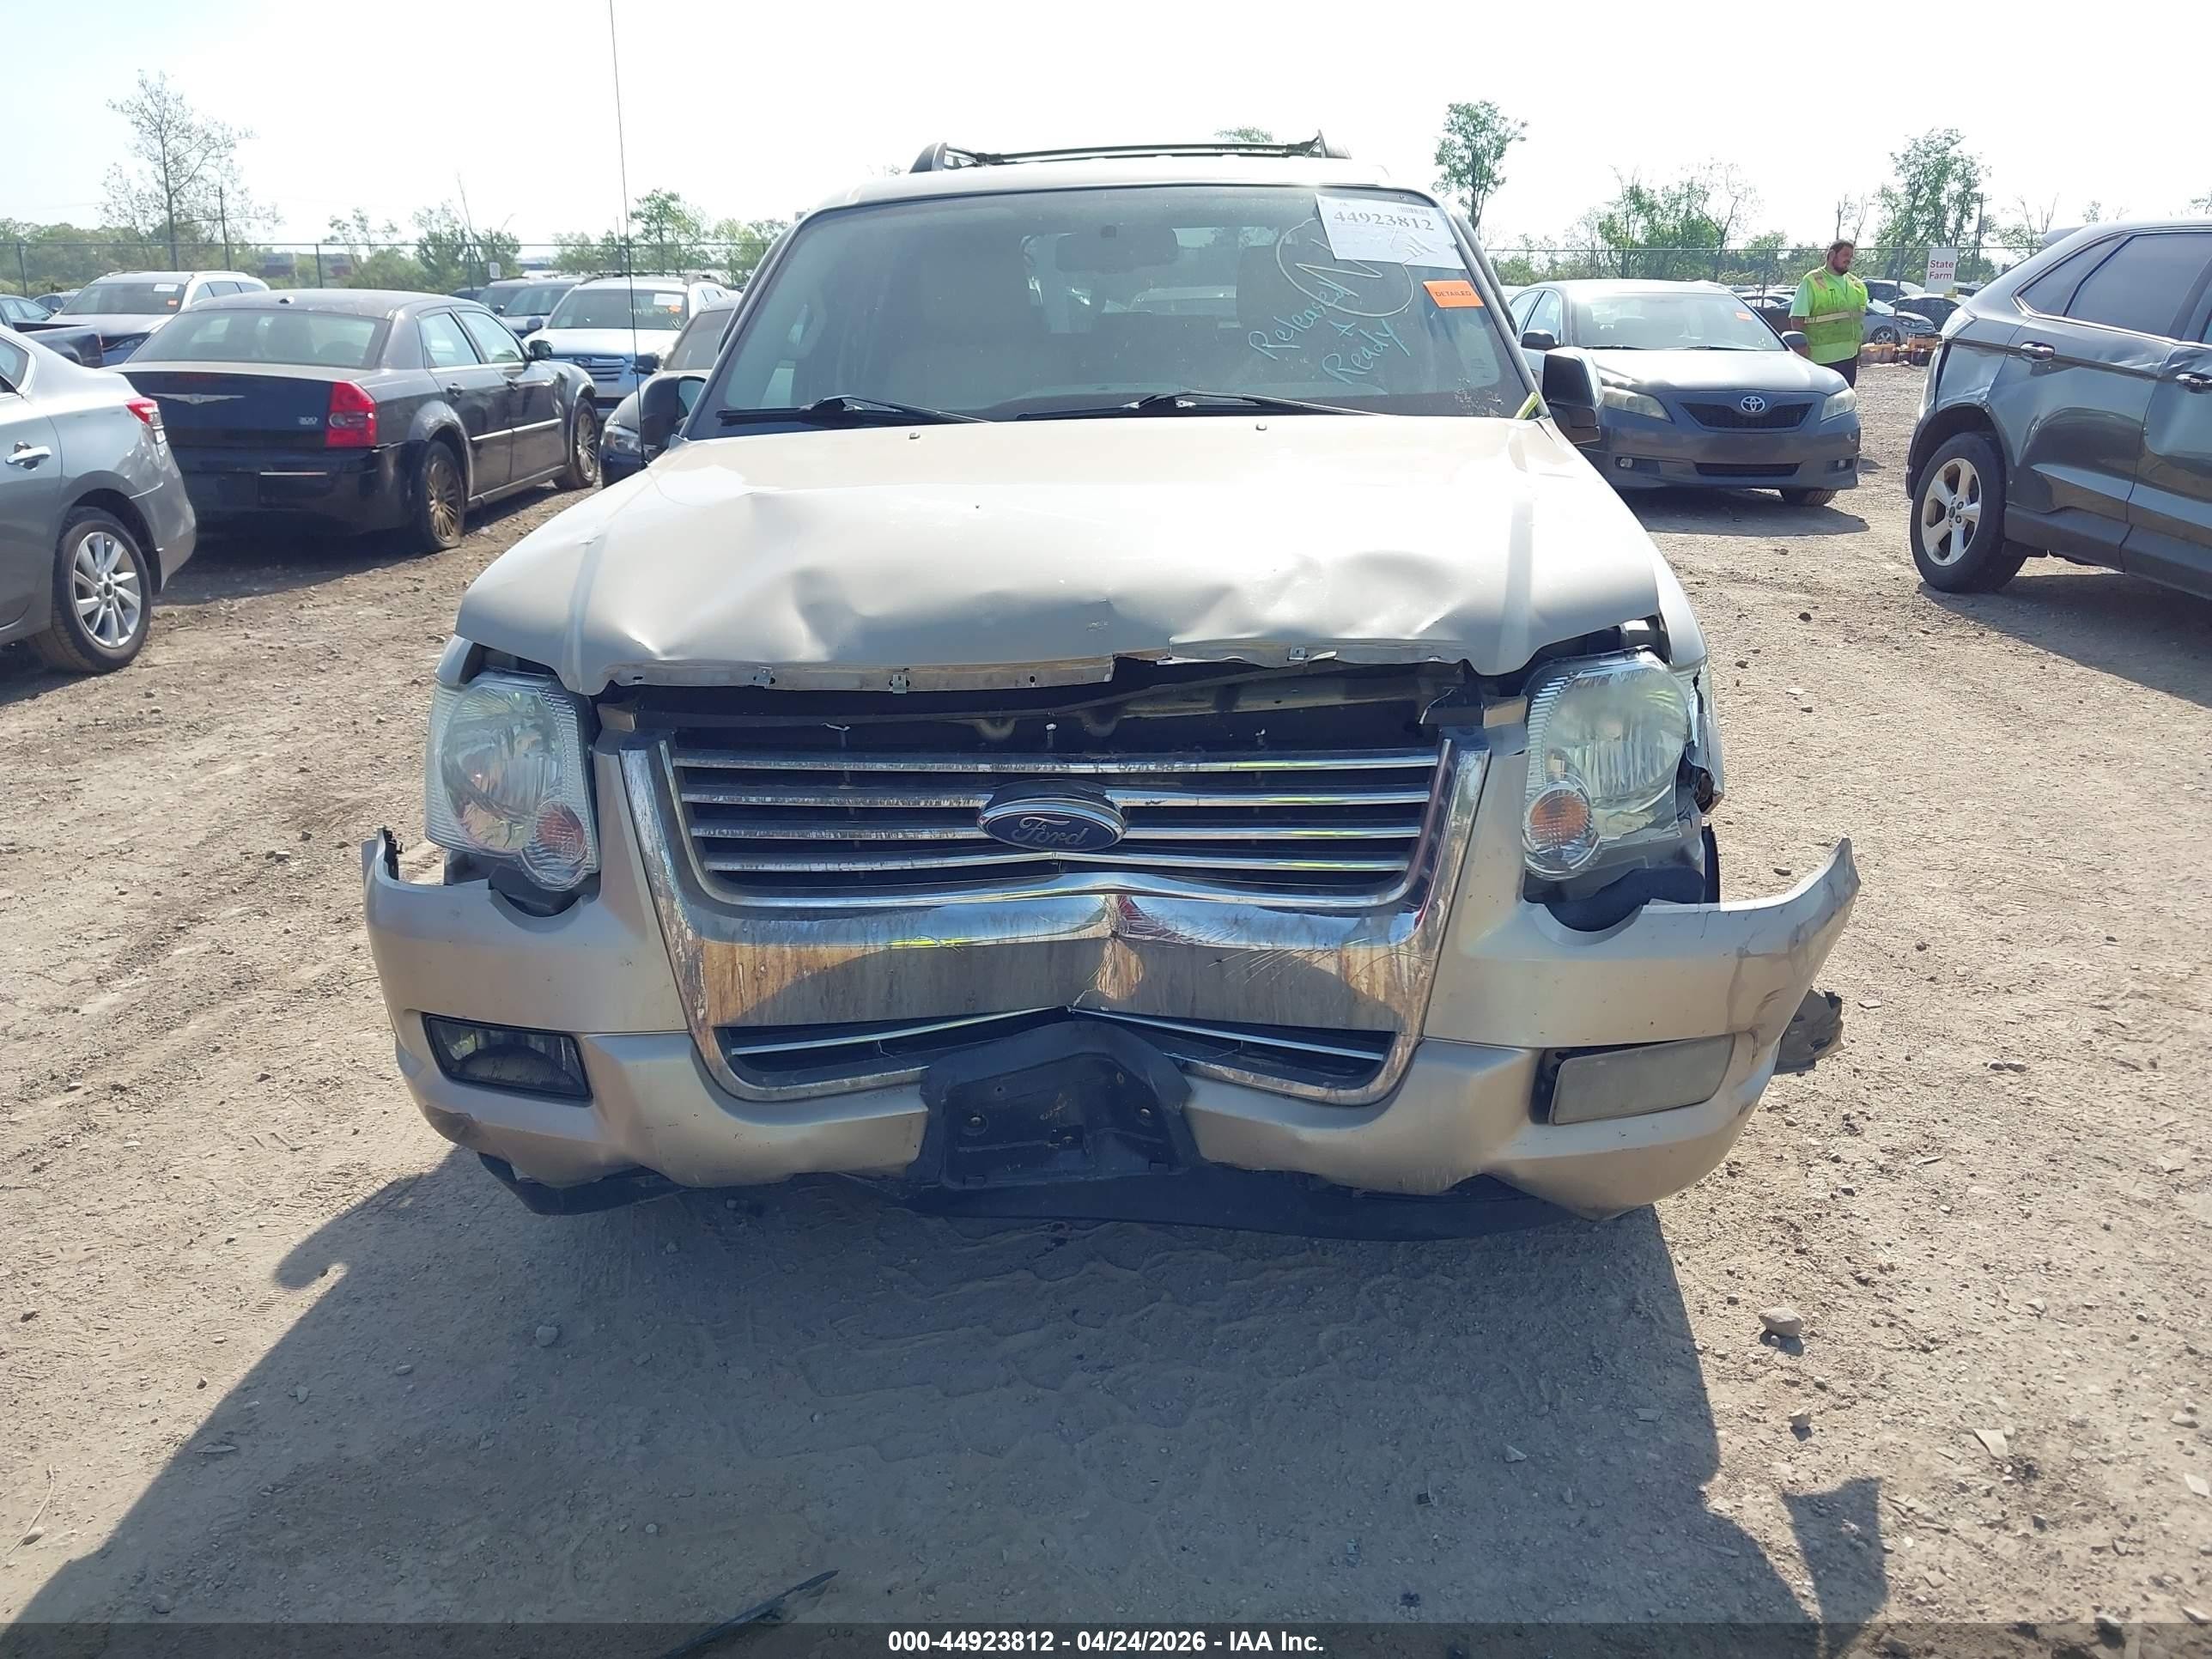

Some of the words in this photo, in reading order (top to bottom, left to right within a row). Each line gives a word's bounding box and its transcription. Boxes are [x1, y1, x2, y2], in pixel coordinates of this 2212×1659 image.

[1333, 210, 1436, 231] 44923812
[1929, 259, 1954, 269] State
[1929, 270, 1952, 280] Farm
[1322, 318, 1411, 385] Ready
[1011, 817, 1089, 846] Ford
